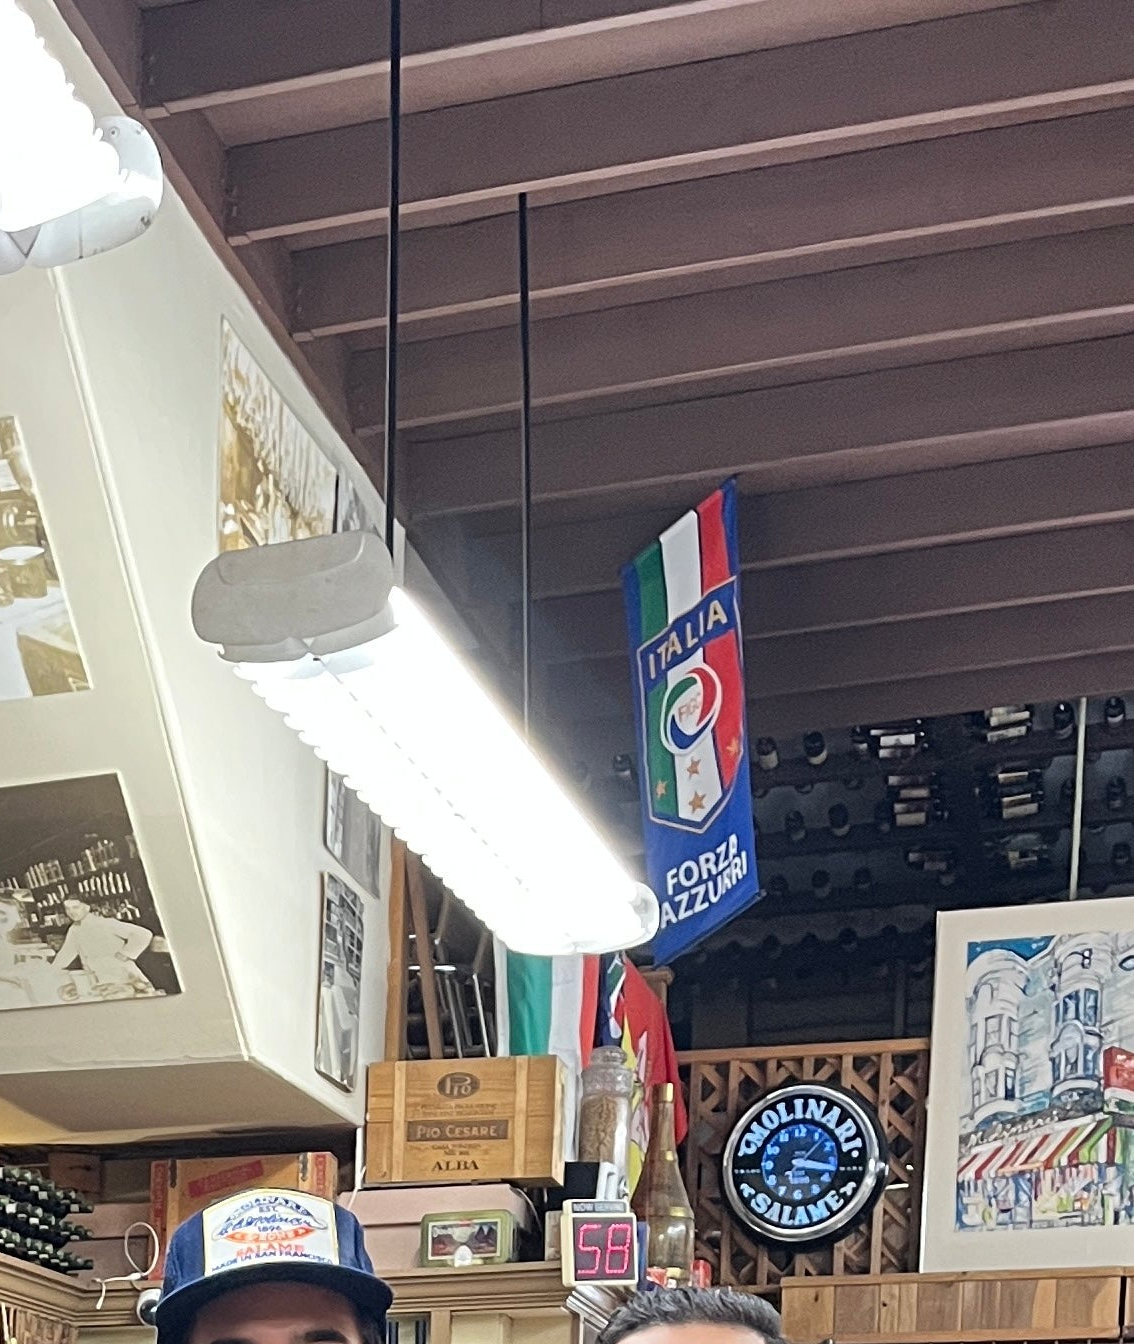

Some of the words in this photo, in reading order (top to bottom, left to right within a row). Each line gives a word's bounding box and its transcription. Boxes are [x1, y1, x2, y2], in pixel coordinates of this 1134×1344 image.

[647, 599, 729, 680] ITALIA
[659, 850, 748, 930] AZZURRI
[666, 833, 739, 895] FORZA
[416, 1125, 442, 1139] PIO
[445, 1124, 499, 1138] CESARE
[737, 1098, 864, 1157] MOLINARI
[431, 1159, 480, 1173] ALBA
[750, 1189, 846, 1227] SALAME
[577, 1223, 632, 1275] 58
